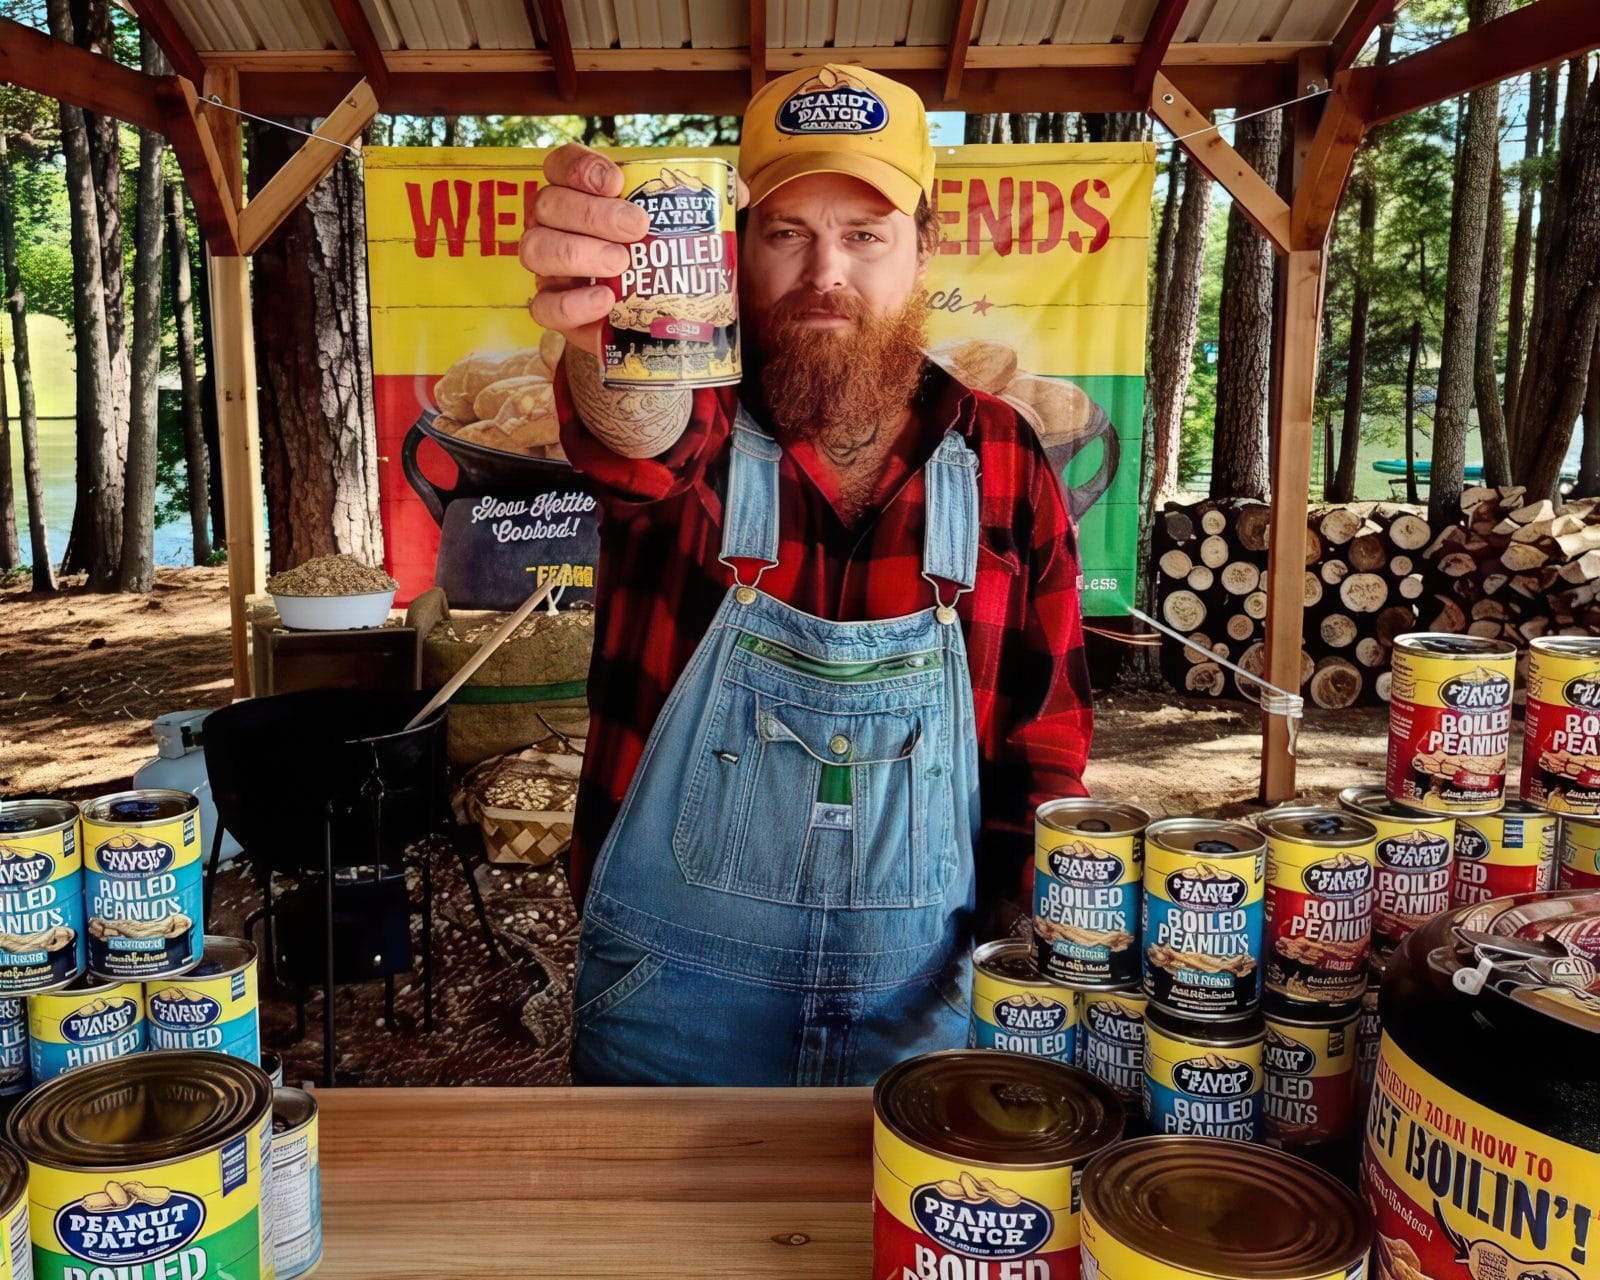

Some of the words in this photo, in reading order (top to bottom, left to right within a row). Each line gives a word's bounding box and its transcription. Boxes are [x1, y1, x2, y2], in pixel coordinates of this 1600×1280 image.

[629, 234, 724, 270] BOILED
[1048, 882, 1123, 910] BOILED
[1167, 908, 1247, 935] BOILED
[1470, 1126, 1518, 1169] NOW
[1524, 1150, 1553, 1183] TO
[1404, 1119, 1593, 1266] BOILIN'!
[69, 1202, 189, 1233] PEANUT
[924, 1196, 1037, 1231] PEANUT
[915, 1243, 1051, 1280] BOILED
